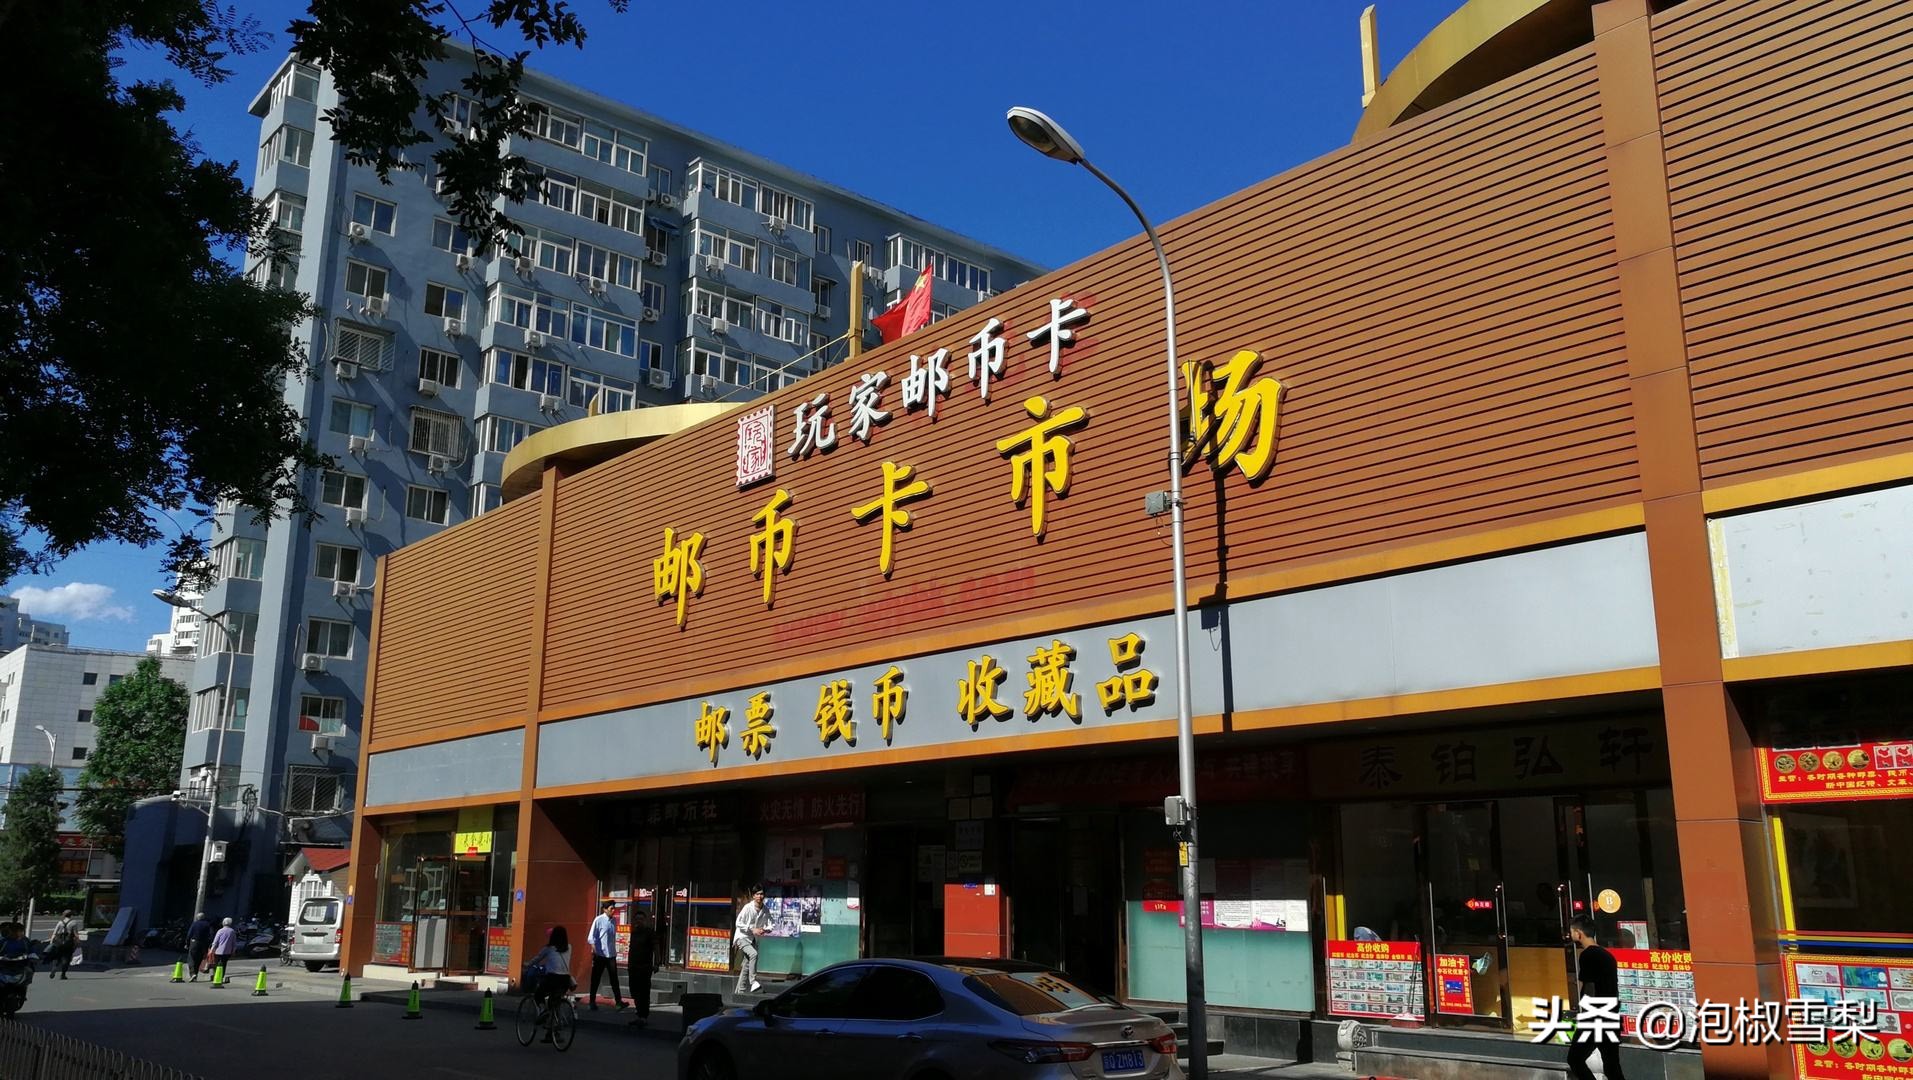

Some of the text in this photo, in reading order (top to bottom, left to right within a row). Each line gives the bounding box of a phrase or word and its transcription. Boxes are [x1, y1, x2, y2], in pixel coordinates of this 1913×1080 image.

[788, 298, 1087, 457] 玩家邮币卡
[653, 349, 1284, 627] 邮币卡市场
[695, 632, 1156, 764] 邮票 钱币 收藏品
[1356, 942, 1390, 953] 高价收购
[1439, 957, 1466, 968] 加油卡
